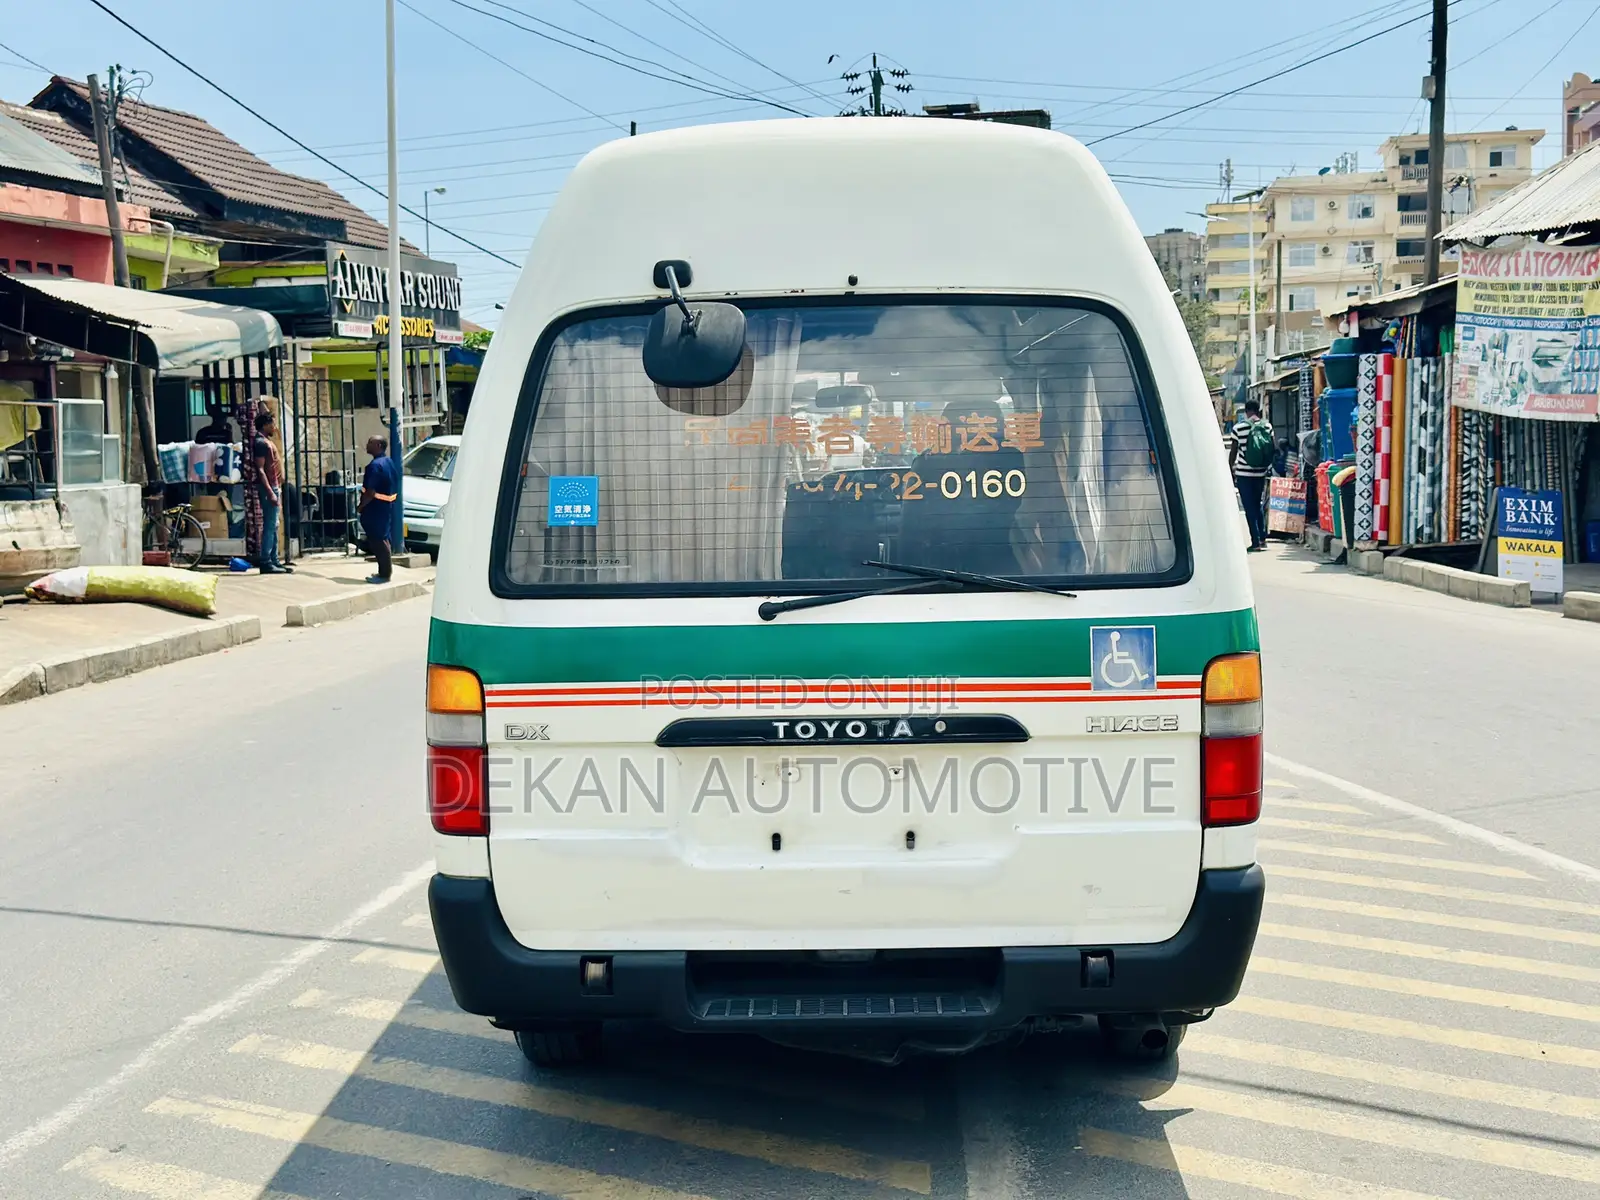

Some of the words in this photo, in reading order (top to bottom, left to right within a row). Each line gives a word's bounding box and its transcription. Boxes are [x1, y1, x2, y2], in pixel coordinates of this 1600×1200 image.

[382, 267, 416, 307] AR
[418, 272, 462, 311] SOUND
[374, 314, 434, 338] ACSSORIES
[1505, 497, 1553, 513] EXIM
[1505, 510, 1556, 526] BANK
[1505, 541, 1556, 554] WAKALA
[504, 723, 550, 740] DX
[772, 721, 914, 742] TOYOTA
[1085, 715, 1179, 733] HIACE
